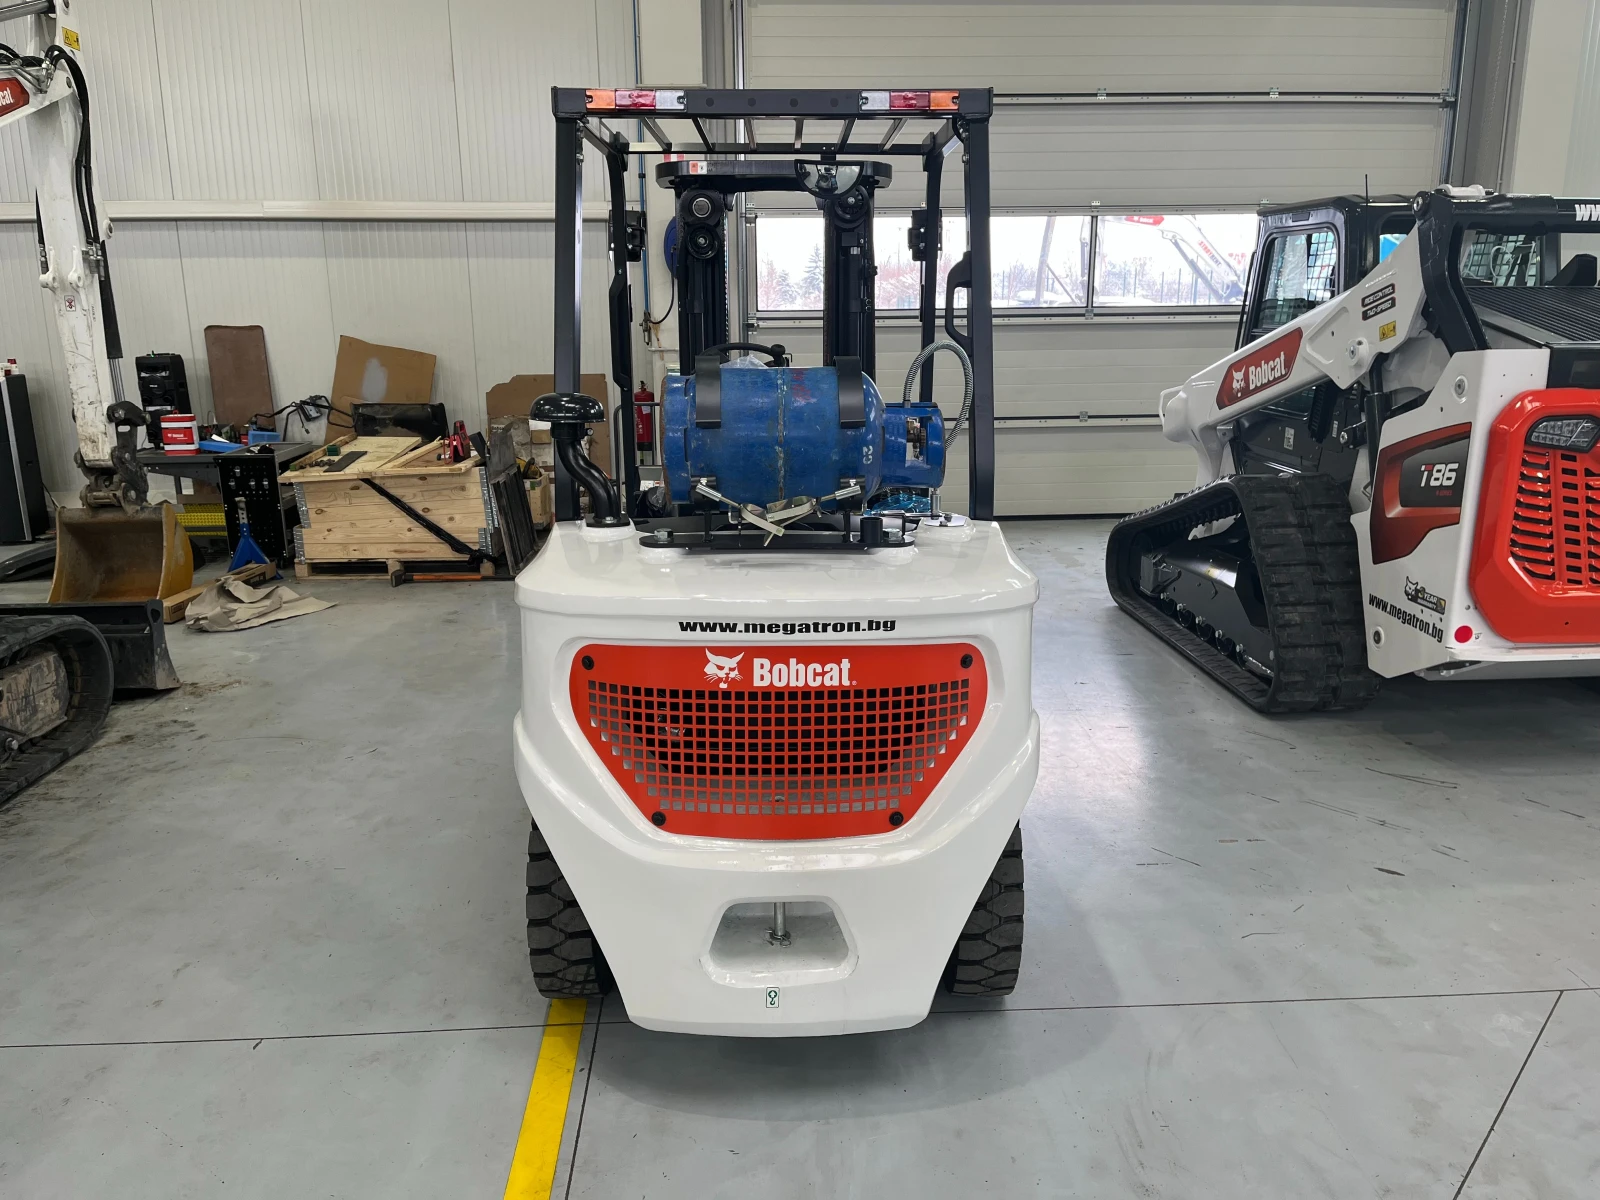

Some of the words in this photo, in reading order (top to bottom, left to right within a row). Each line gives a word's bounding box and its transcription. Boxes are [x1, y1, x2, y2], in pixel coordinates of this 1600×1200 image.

[1248, 351, 1286, 390] Bobcat
[1420, 463, 1459, 487] T86
[1424, 593, 1438, 604] YEAR
[678, 619, 896, 635] www.megatron.bg
[1368, 593, 1444, 643] www.megatron.bg
[753, 658, 851, 687] Bobcat
